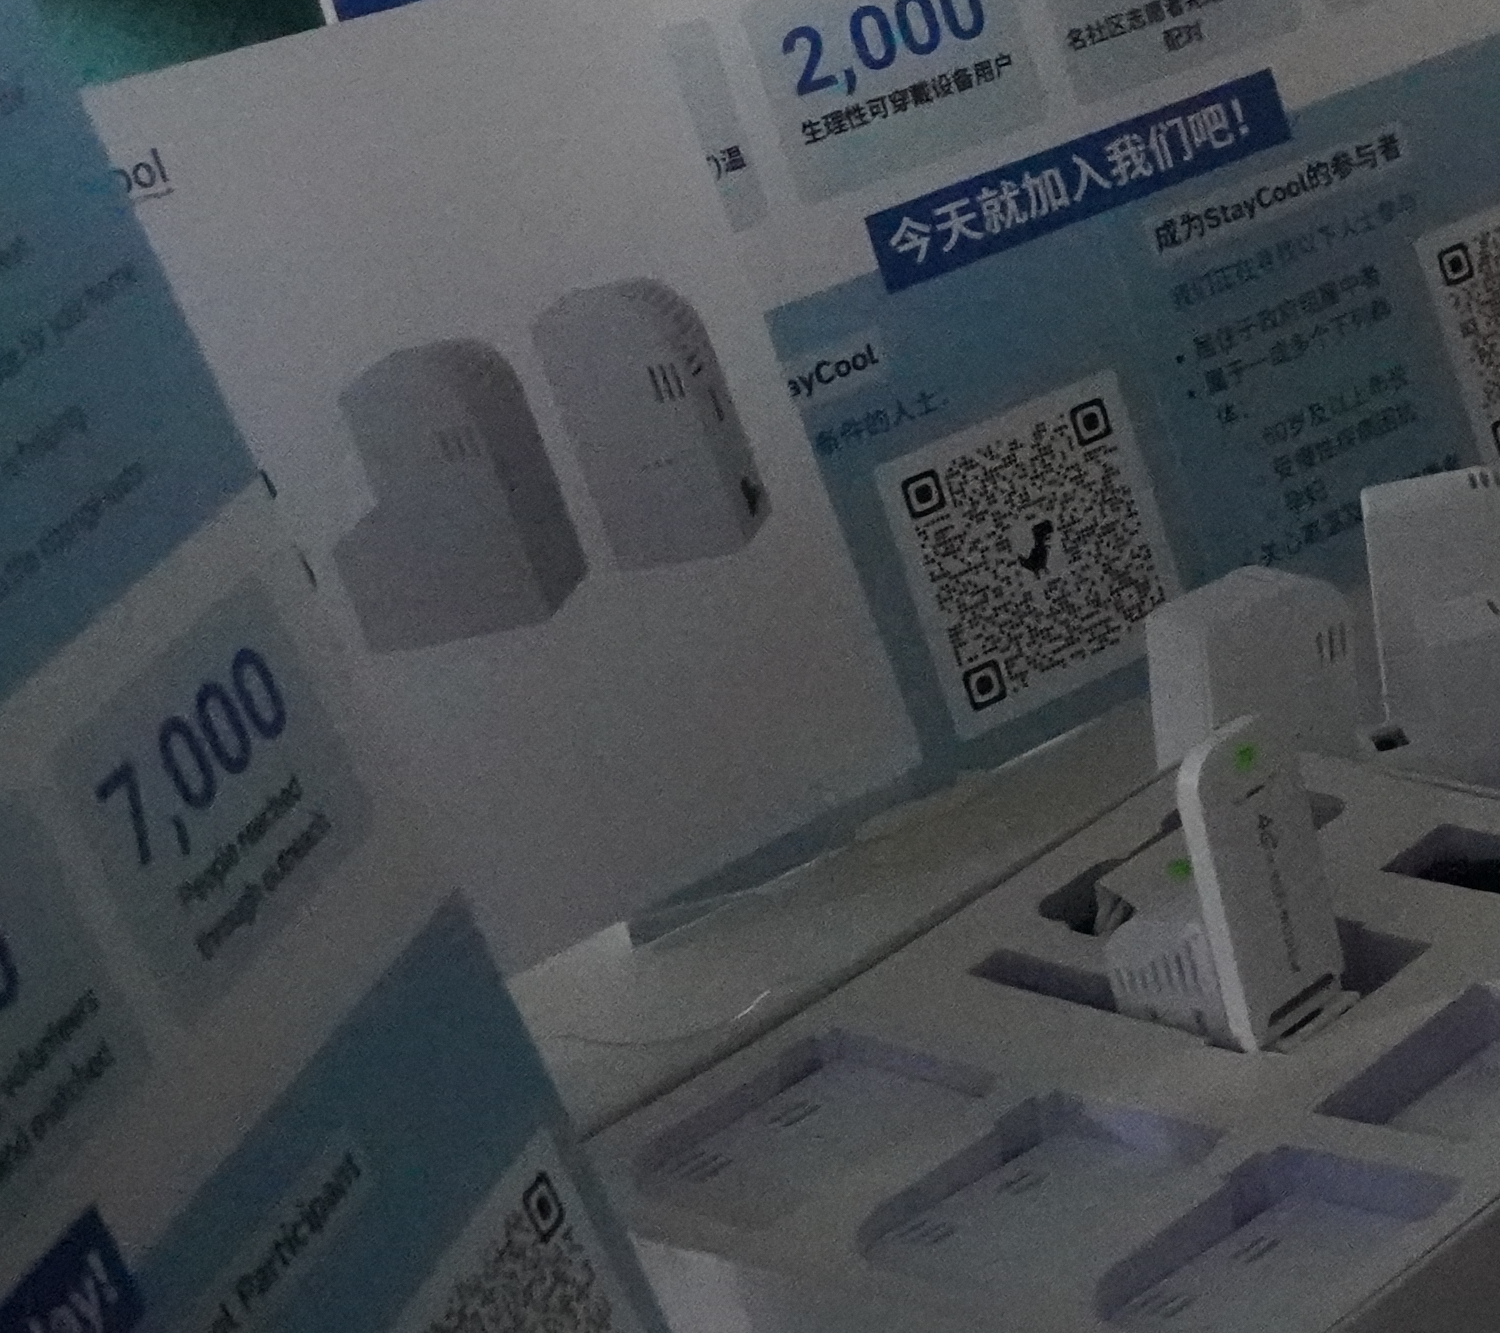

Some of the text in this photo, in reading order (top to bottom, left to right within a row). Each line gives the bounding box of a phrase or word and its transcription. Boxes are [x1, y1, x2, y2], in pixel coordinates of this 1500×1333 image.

[802, 53, 1013, 144] 生理性可穿戴设备用户
[887, 95, 1250, 267] 今天就加入我们吧！
[1155, 134, 1403, 254] 成为StayCool的参与者
[95, 647, 288, 866] 7,000
